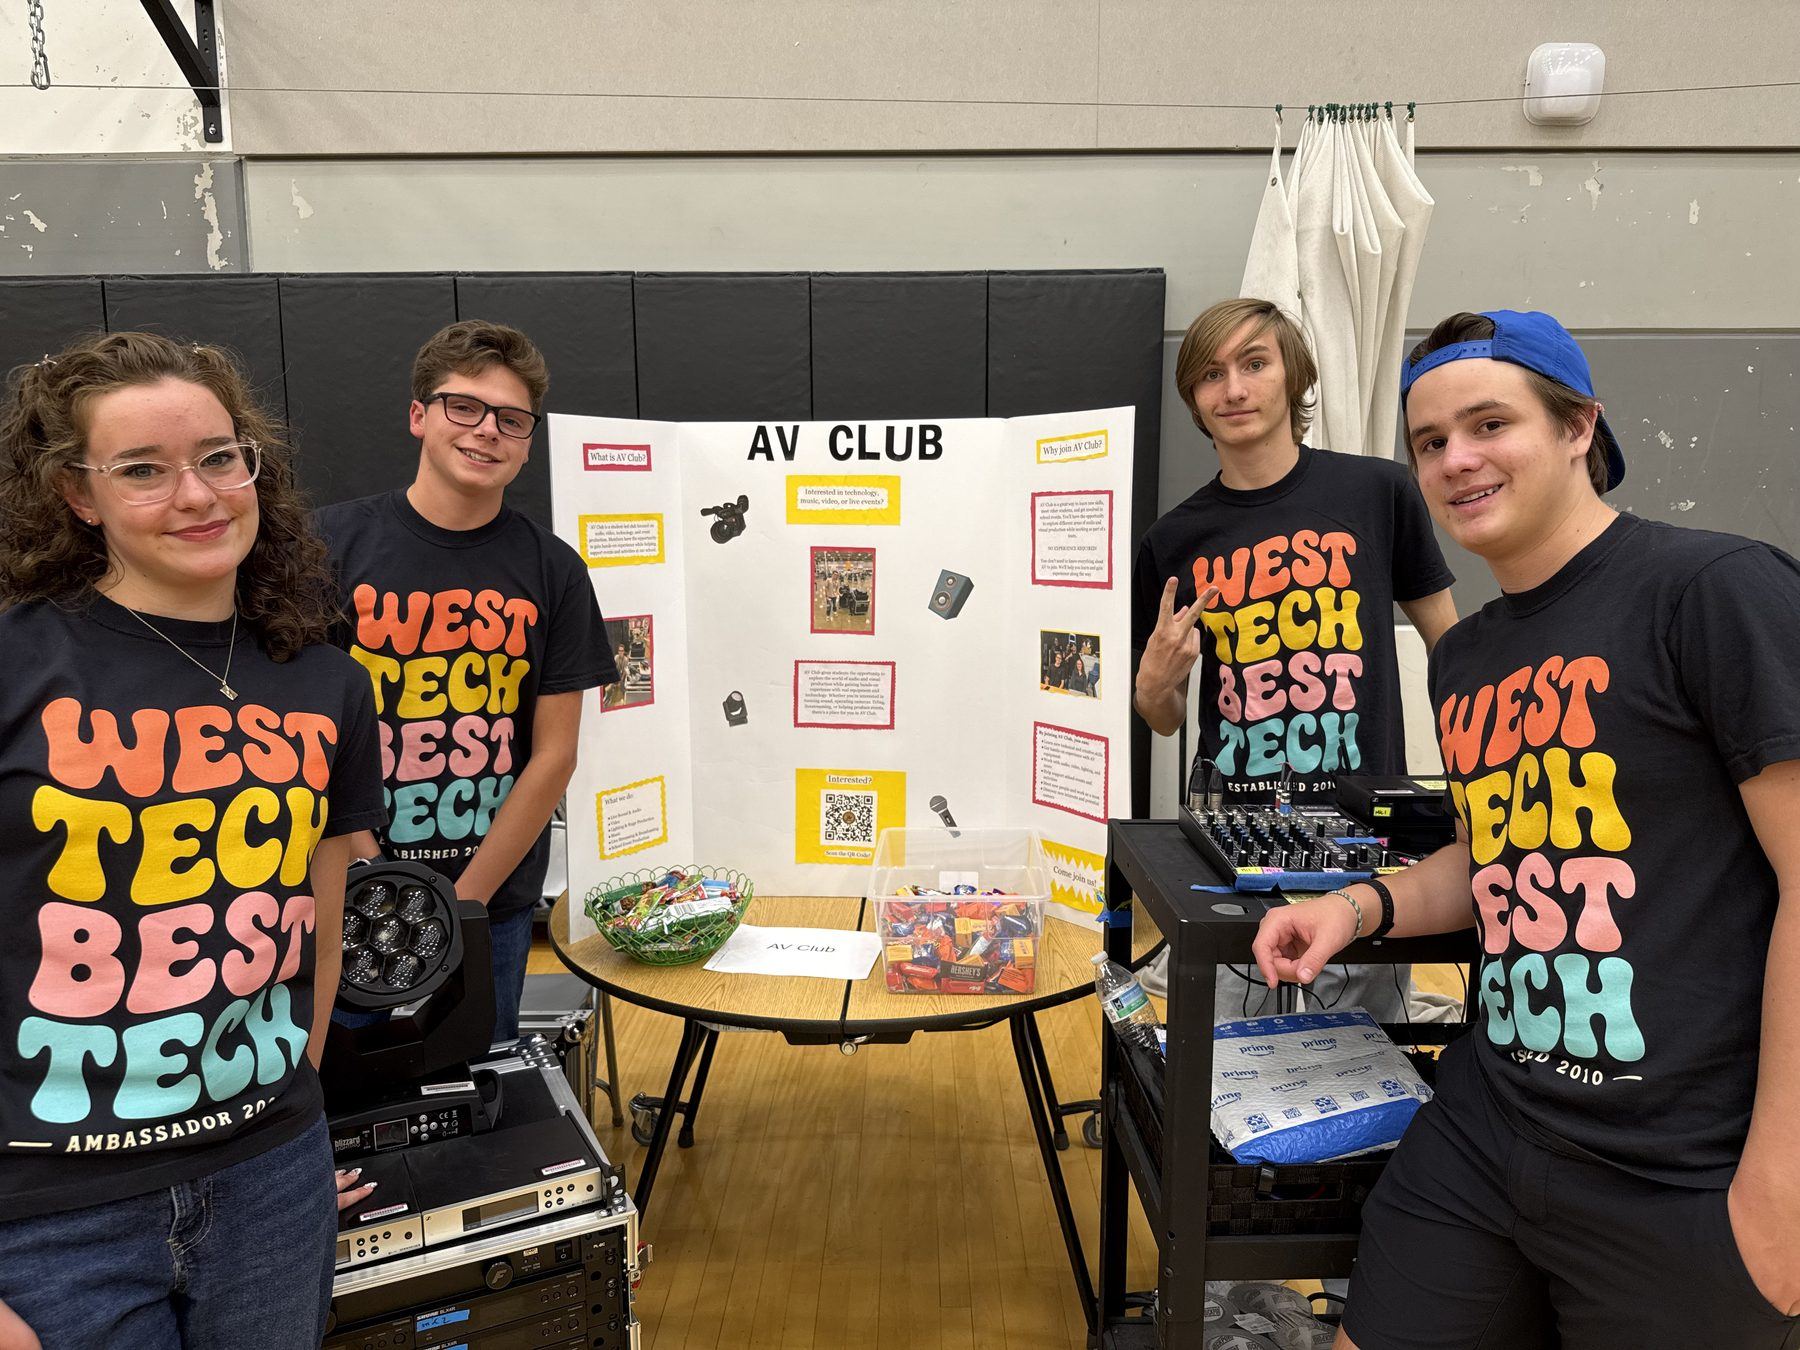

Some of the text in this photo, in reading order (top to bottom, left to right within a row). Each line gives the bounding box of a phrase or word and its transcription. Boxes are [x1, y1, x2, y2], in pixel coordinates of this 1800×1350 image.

[590, 453, 608, 461] What
[628, 454, 646, 462] Club?
[747, 424, 943, 461] AV CLUB
[1043, 440, 1102, 456] Why join AV Club?
[1192, 529, 1356, 609] WEST
[354, 584, 538, 656] WEST
[1201, 587, 1363, 664] TECH
[350, 645, 530, 718] TECH
[1218, 651, 1363, 723] BEST
[1215, 712, 1362, 776] TECH
[1440, 655, 1610, 775] WEST
[41, 697, 338, 798] WEST
[384, 775, 515, 843] ECH
[828, 776, 872, 784] Interested?
[1228, 780, 1306, 793] ESTABLISED
[32, 785, 328, 906] TECH
[1053, 865, 1096, 887] Come join us!
[1472, 852, 1636, 955] EST
[28, 891, 316, 1018] BEST
[950, 965, 981, 976] HERSHEY'S
[1479, 952, 1646, 1062] ECH
[17, 983, 309, 1124] TECH
[1222, 1069, 1259, 1078] prime
[1240, 1044, 1275, 1054] prime
[1301, 1037, 1337, 1048] prime
[1556, 1060, 1603, 1085] 2010
[1270, 1079, 1308, 1092] prime
[65, 1111, 233, 1154] AMBASSADOR
